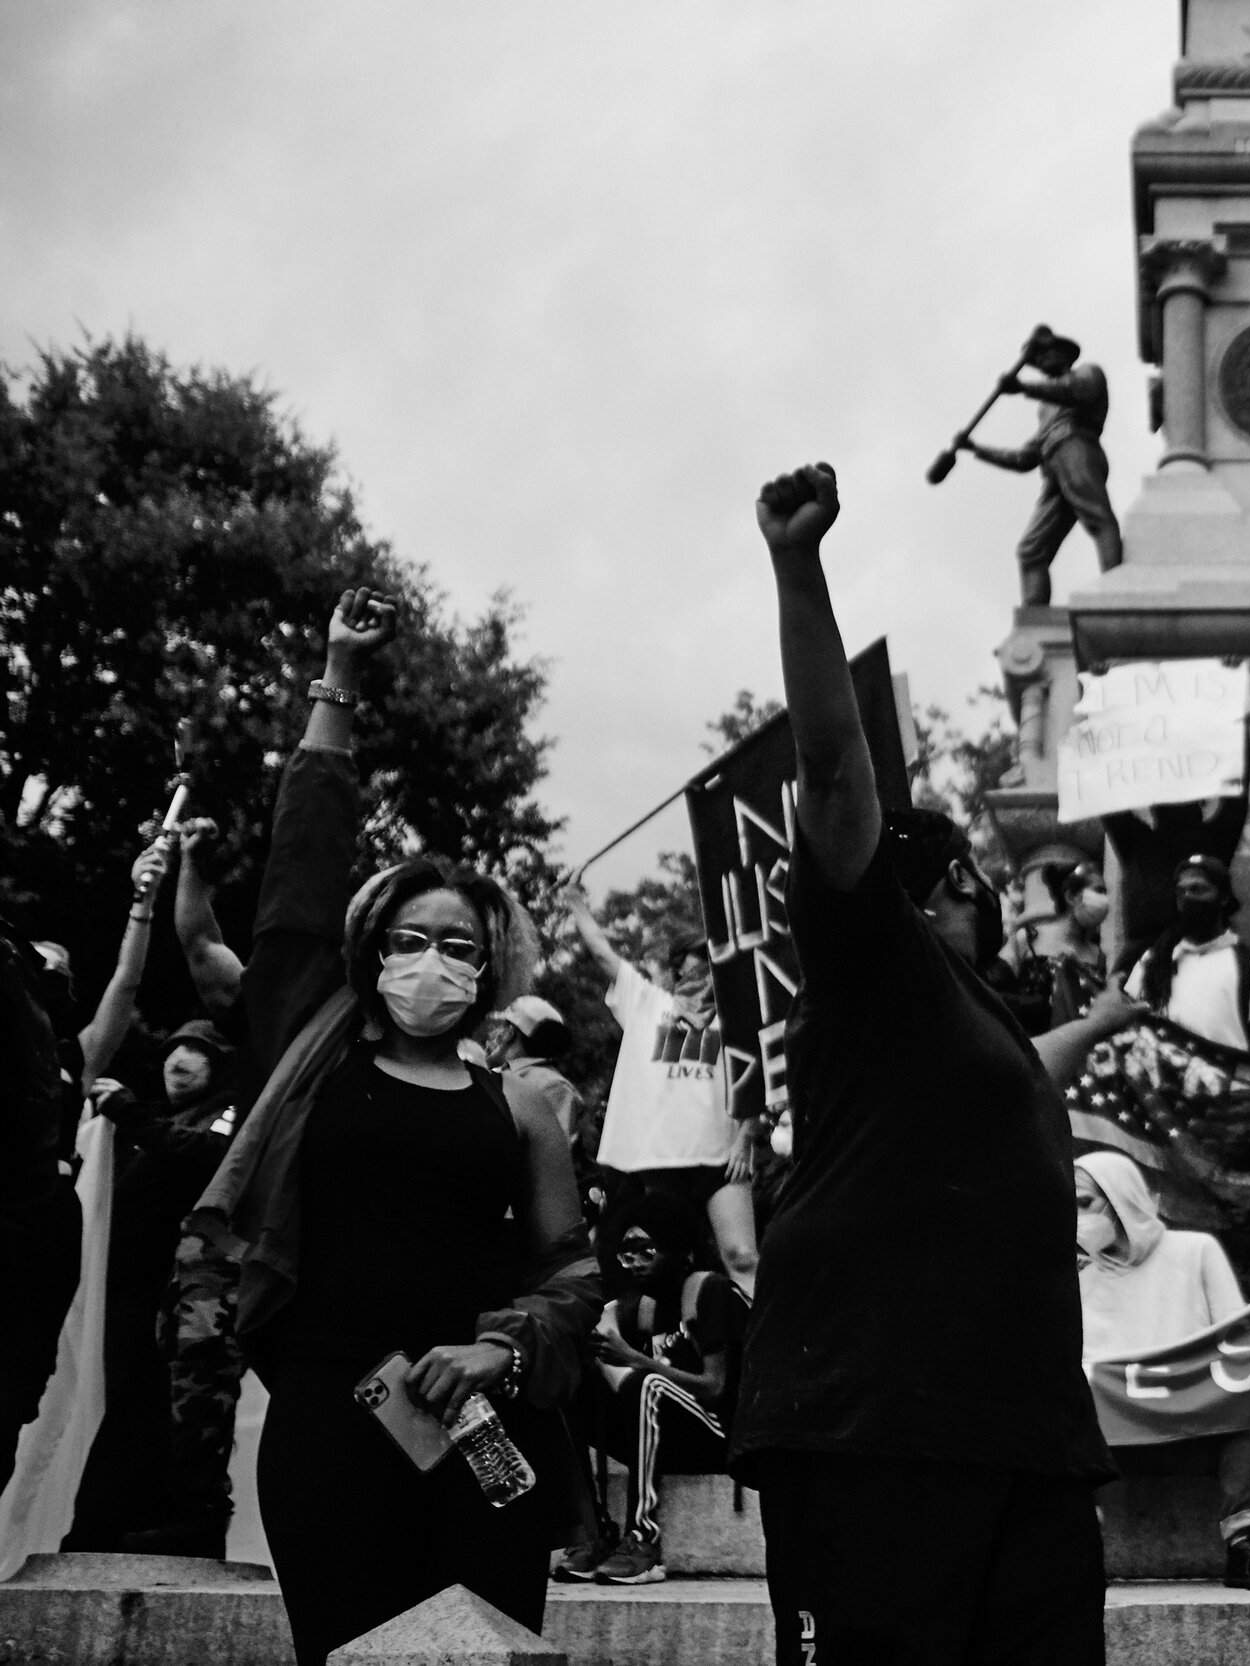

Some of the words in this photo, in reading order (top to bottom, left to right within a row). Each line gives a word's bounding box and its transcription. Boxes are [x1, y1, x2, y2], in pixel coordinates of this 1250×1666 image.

[1077, 722, 1140, 758] NOT
[733, 779, 797, 869] N
[667, 1064, 714, 1080] LIVES
